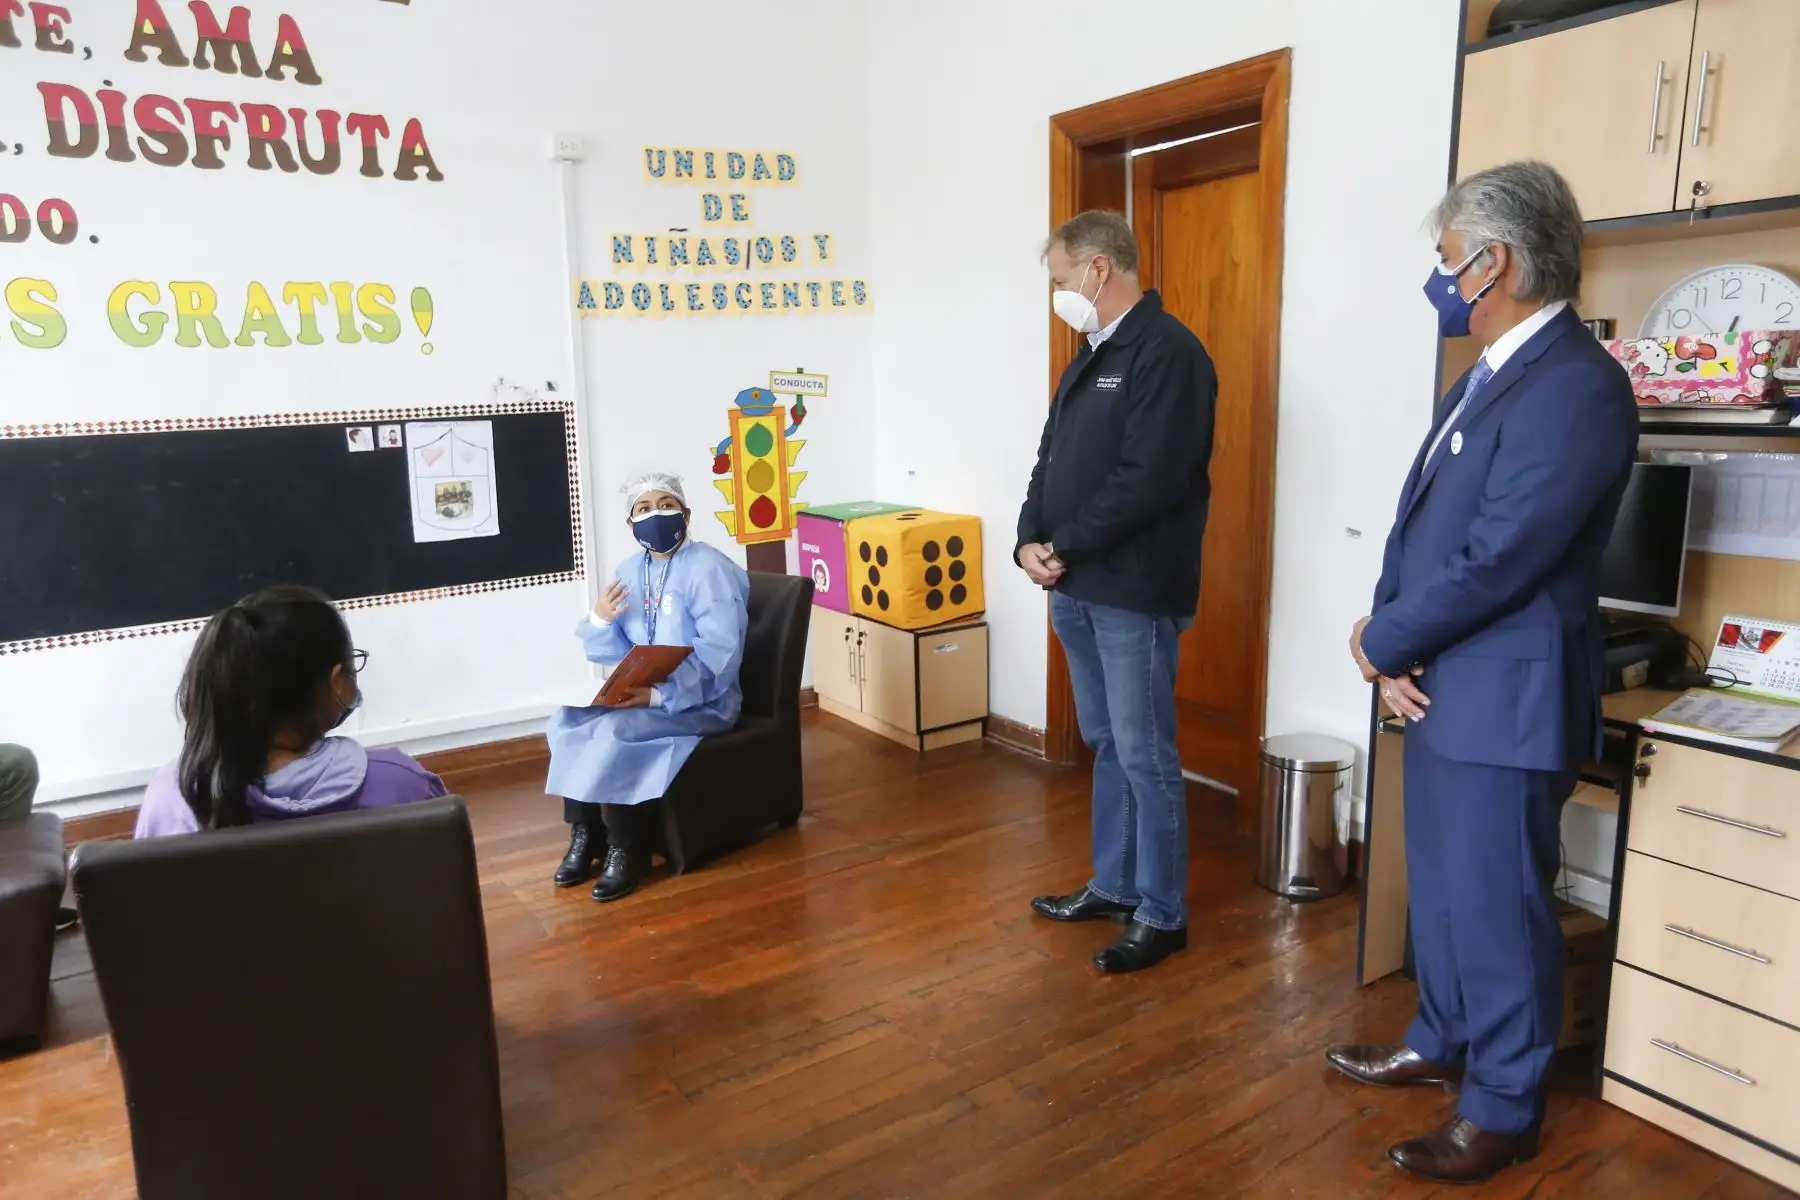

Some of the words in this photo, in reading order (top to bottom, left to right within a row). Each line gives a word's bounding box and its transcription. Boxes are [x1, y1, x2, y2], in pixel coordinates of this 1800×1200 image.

[123, 0, 323, 86] AMA
[644, 147, 797, 181] UNIDAD
[702, 193, 749, 222] DE
[813, 234, 830, 260] Y
[576, 279, 868, 312] ADOLESCENTES
[1695, 287, 1708, 308] 11
[1721, 278, 1742, 299] 12
[106, 279, 434, 356] GRATIS!
[1666, 308, 1692, 330] 10
[1773, 301, 1794, 324] 2
[773, 377, 824, 389] CONDUCTA
